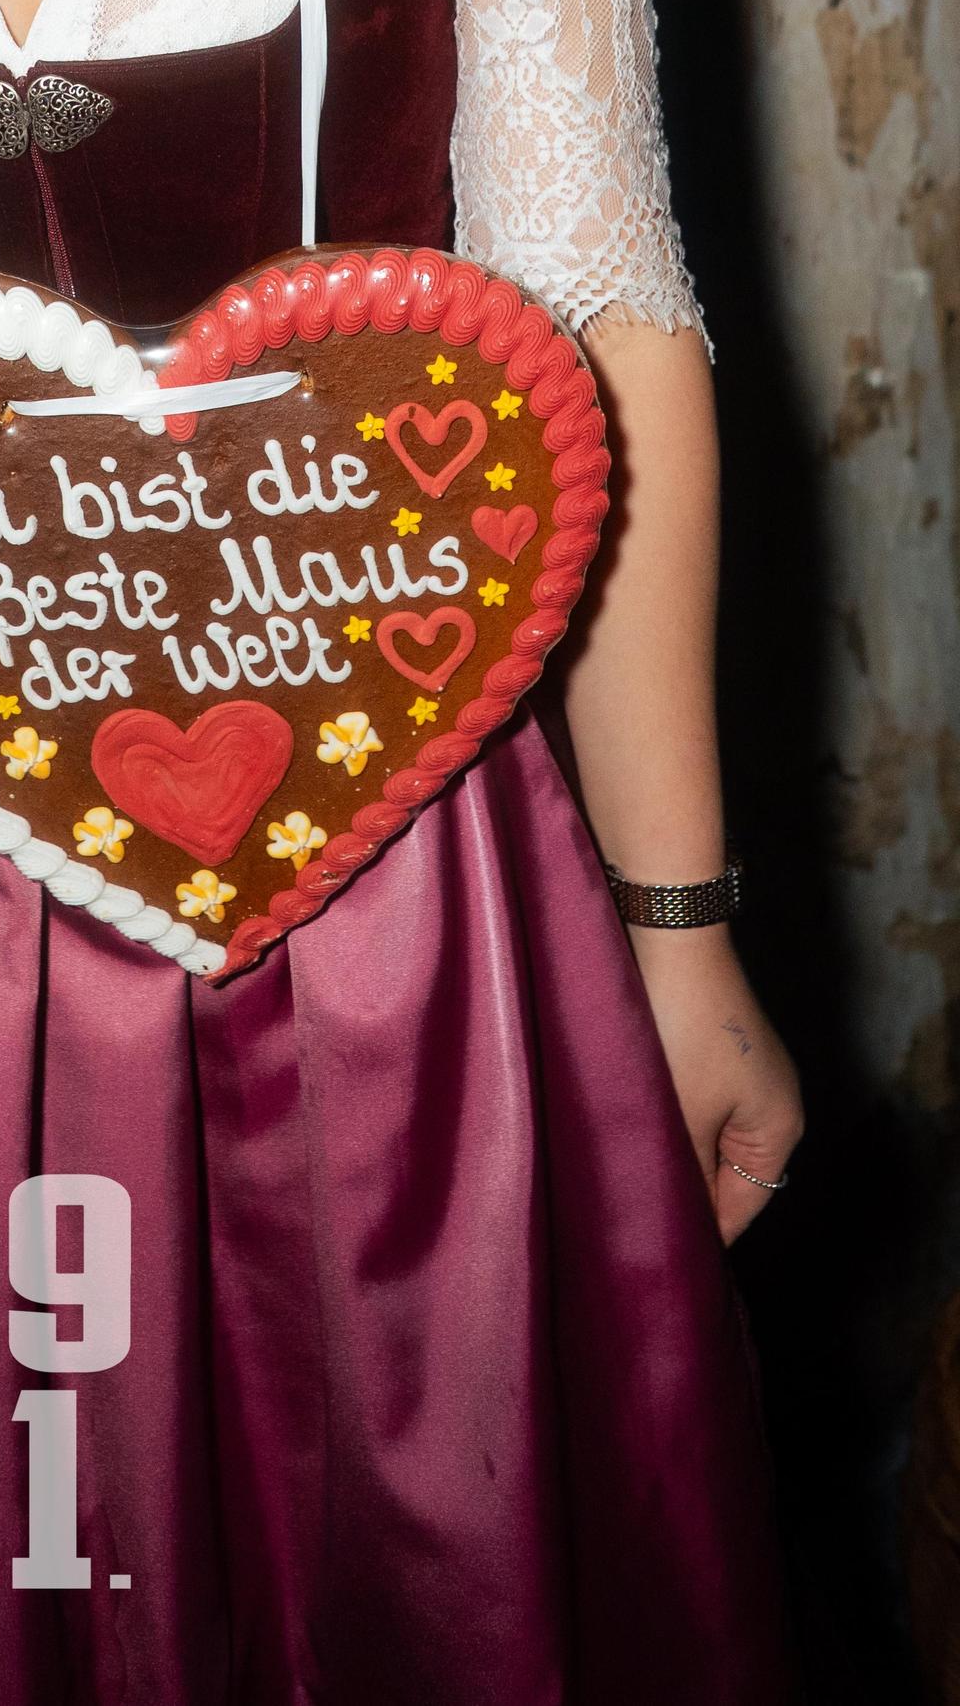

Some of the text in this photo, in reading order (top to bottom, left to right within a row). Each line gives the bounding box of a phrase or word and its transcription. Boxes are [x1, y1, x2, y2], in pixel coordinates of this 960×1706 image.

[49, 451, 232, 540] bist
[247, 434, 380, 516] die
[210, 535, 468, 615] Maus
[21, 639, 137, 711] der
